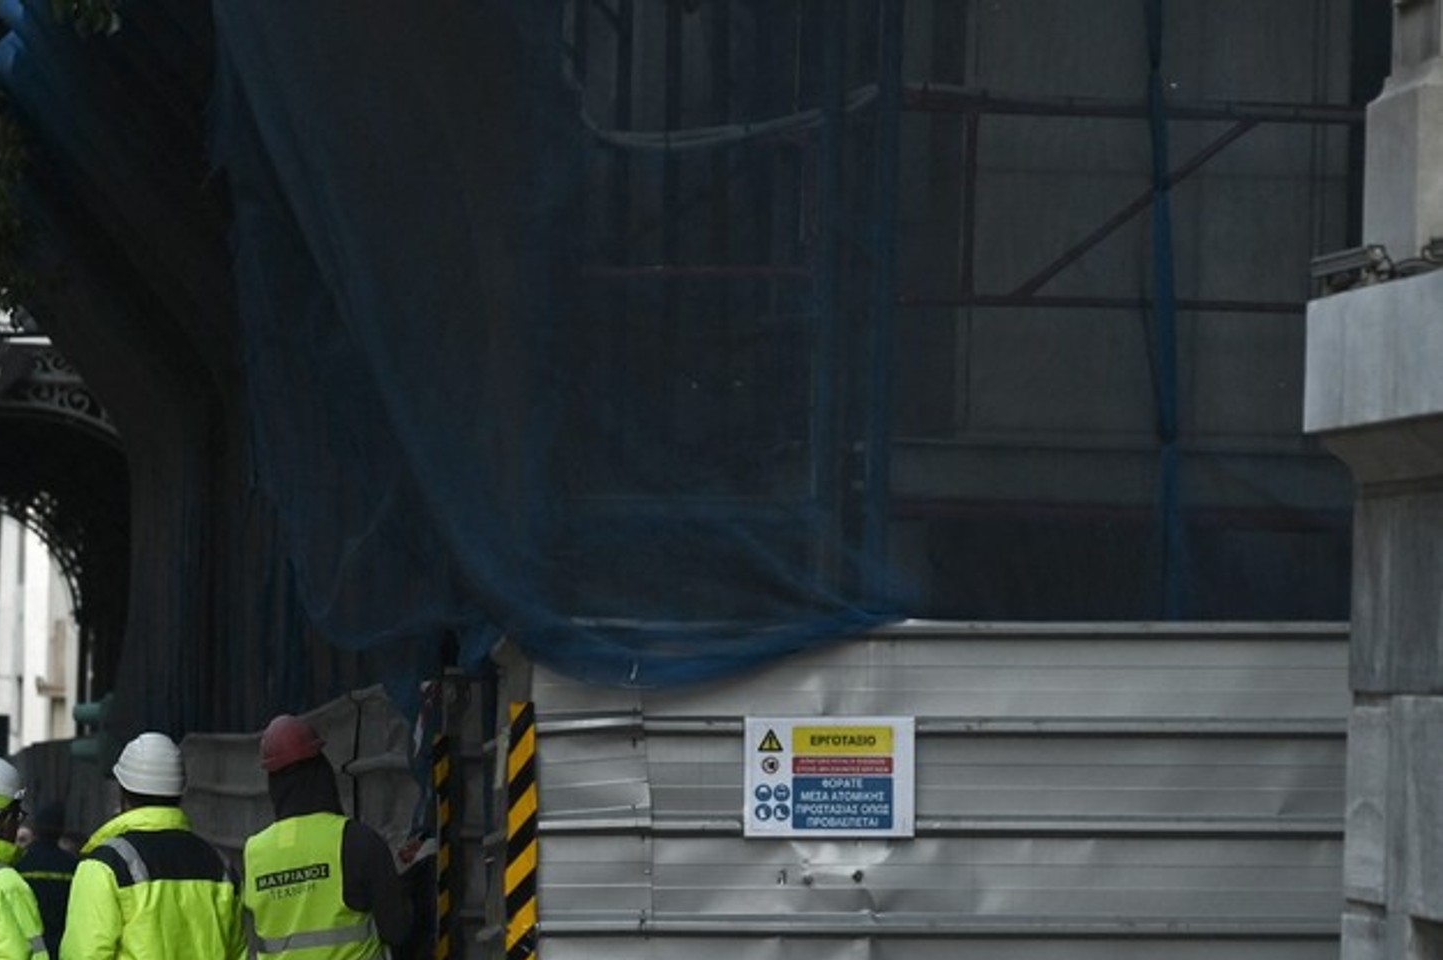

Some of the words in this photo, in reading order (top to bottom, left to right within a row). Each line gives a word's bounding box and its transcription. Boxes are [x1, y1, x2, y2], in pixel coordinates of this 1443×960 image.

[810, 735, 876, 746] ΕΡΓΟΤΑΞΙΟ
[822, 777, 862, 788] ΦΟΡΑΤΕ
[801, 791, 829, 801] ΜΕΣΑ
[831, 791, 884, 801] ΑΤΟΜΙΚΗΣ
[795, 804, 857, 814] ΠΡΟΣΤΑΣΙΑΣ
[860, 804, 890, 814] ΟΠΩΣ
[806, 817, 878, 827] ΠΡΟΒΛΕΠΕΤΑΙ
